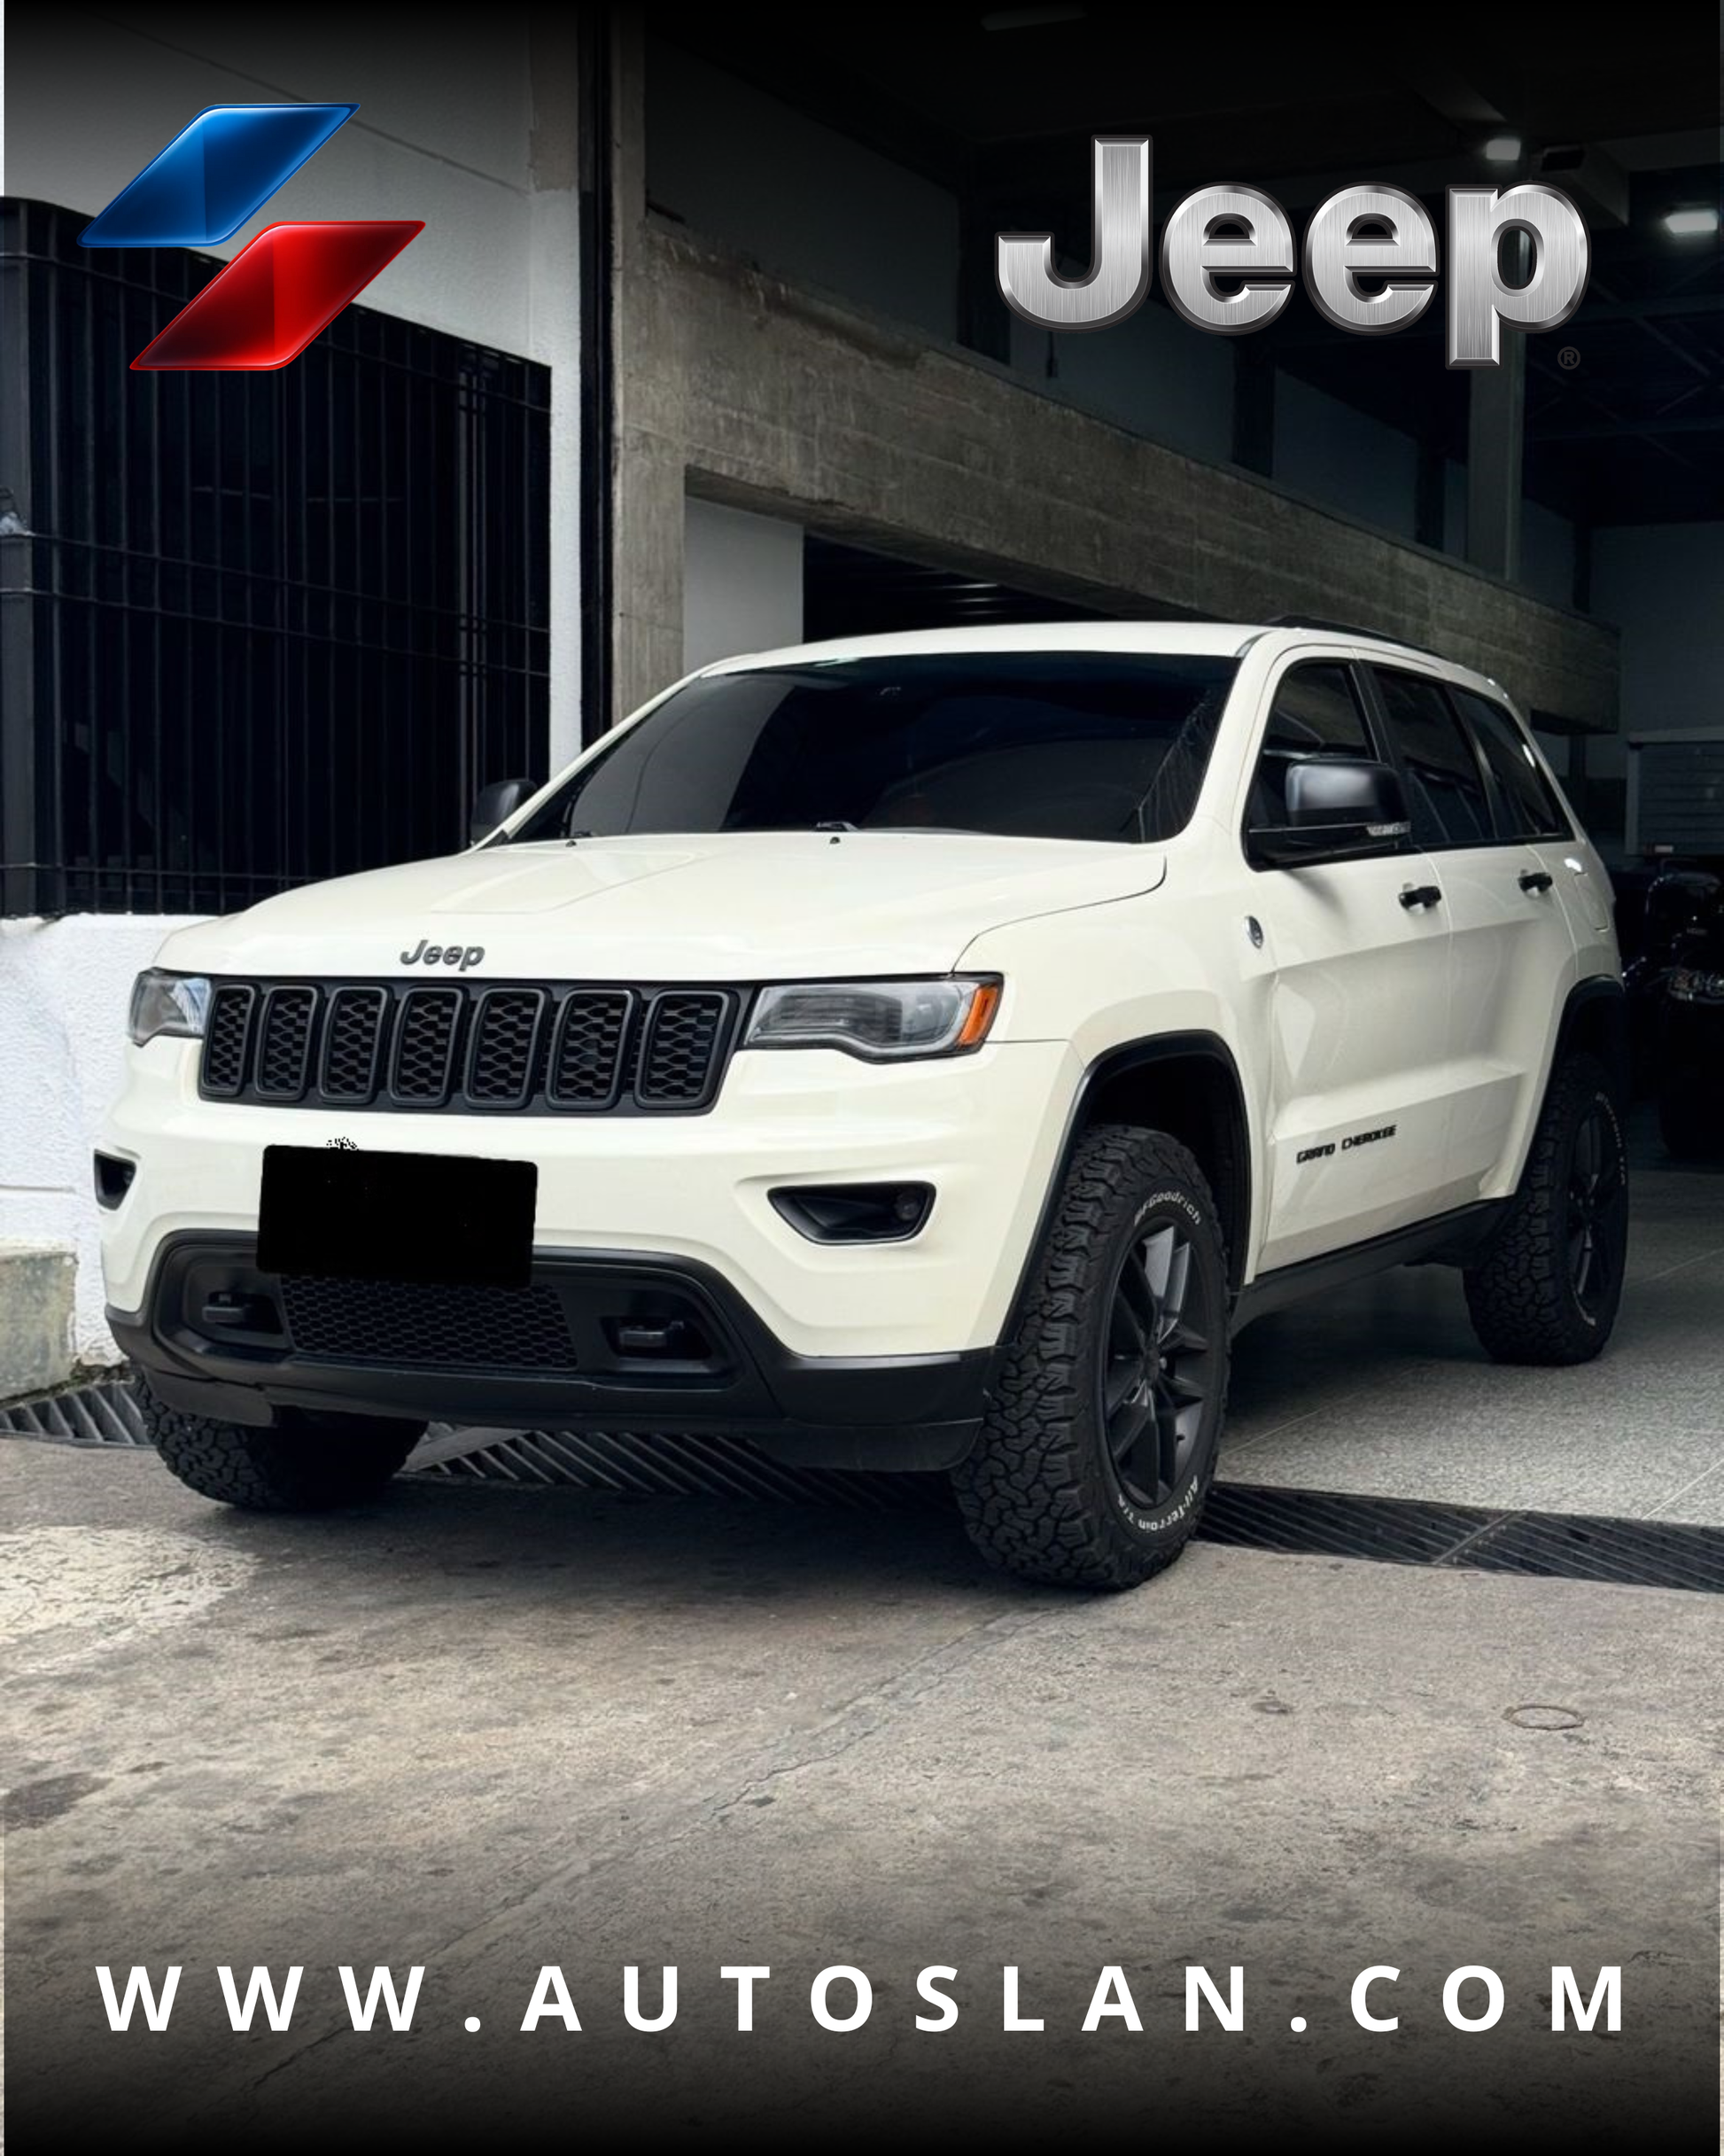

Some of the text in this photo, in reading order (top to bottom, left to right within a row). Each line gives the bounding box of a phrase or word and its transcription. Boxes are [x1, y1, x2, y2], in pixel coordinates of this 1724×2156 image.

[400, 939, 485, 972] Jeep
[1296, 1125, 1397, 1164] GRAND CHEROKEE
